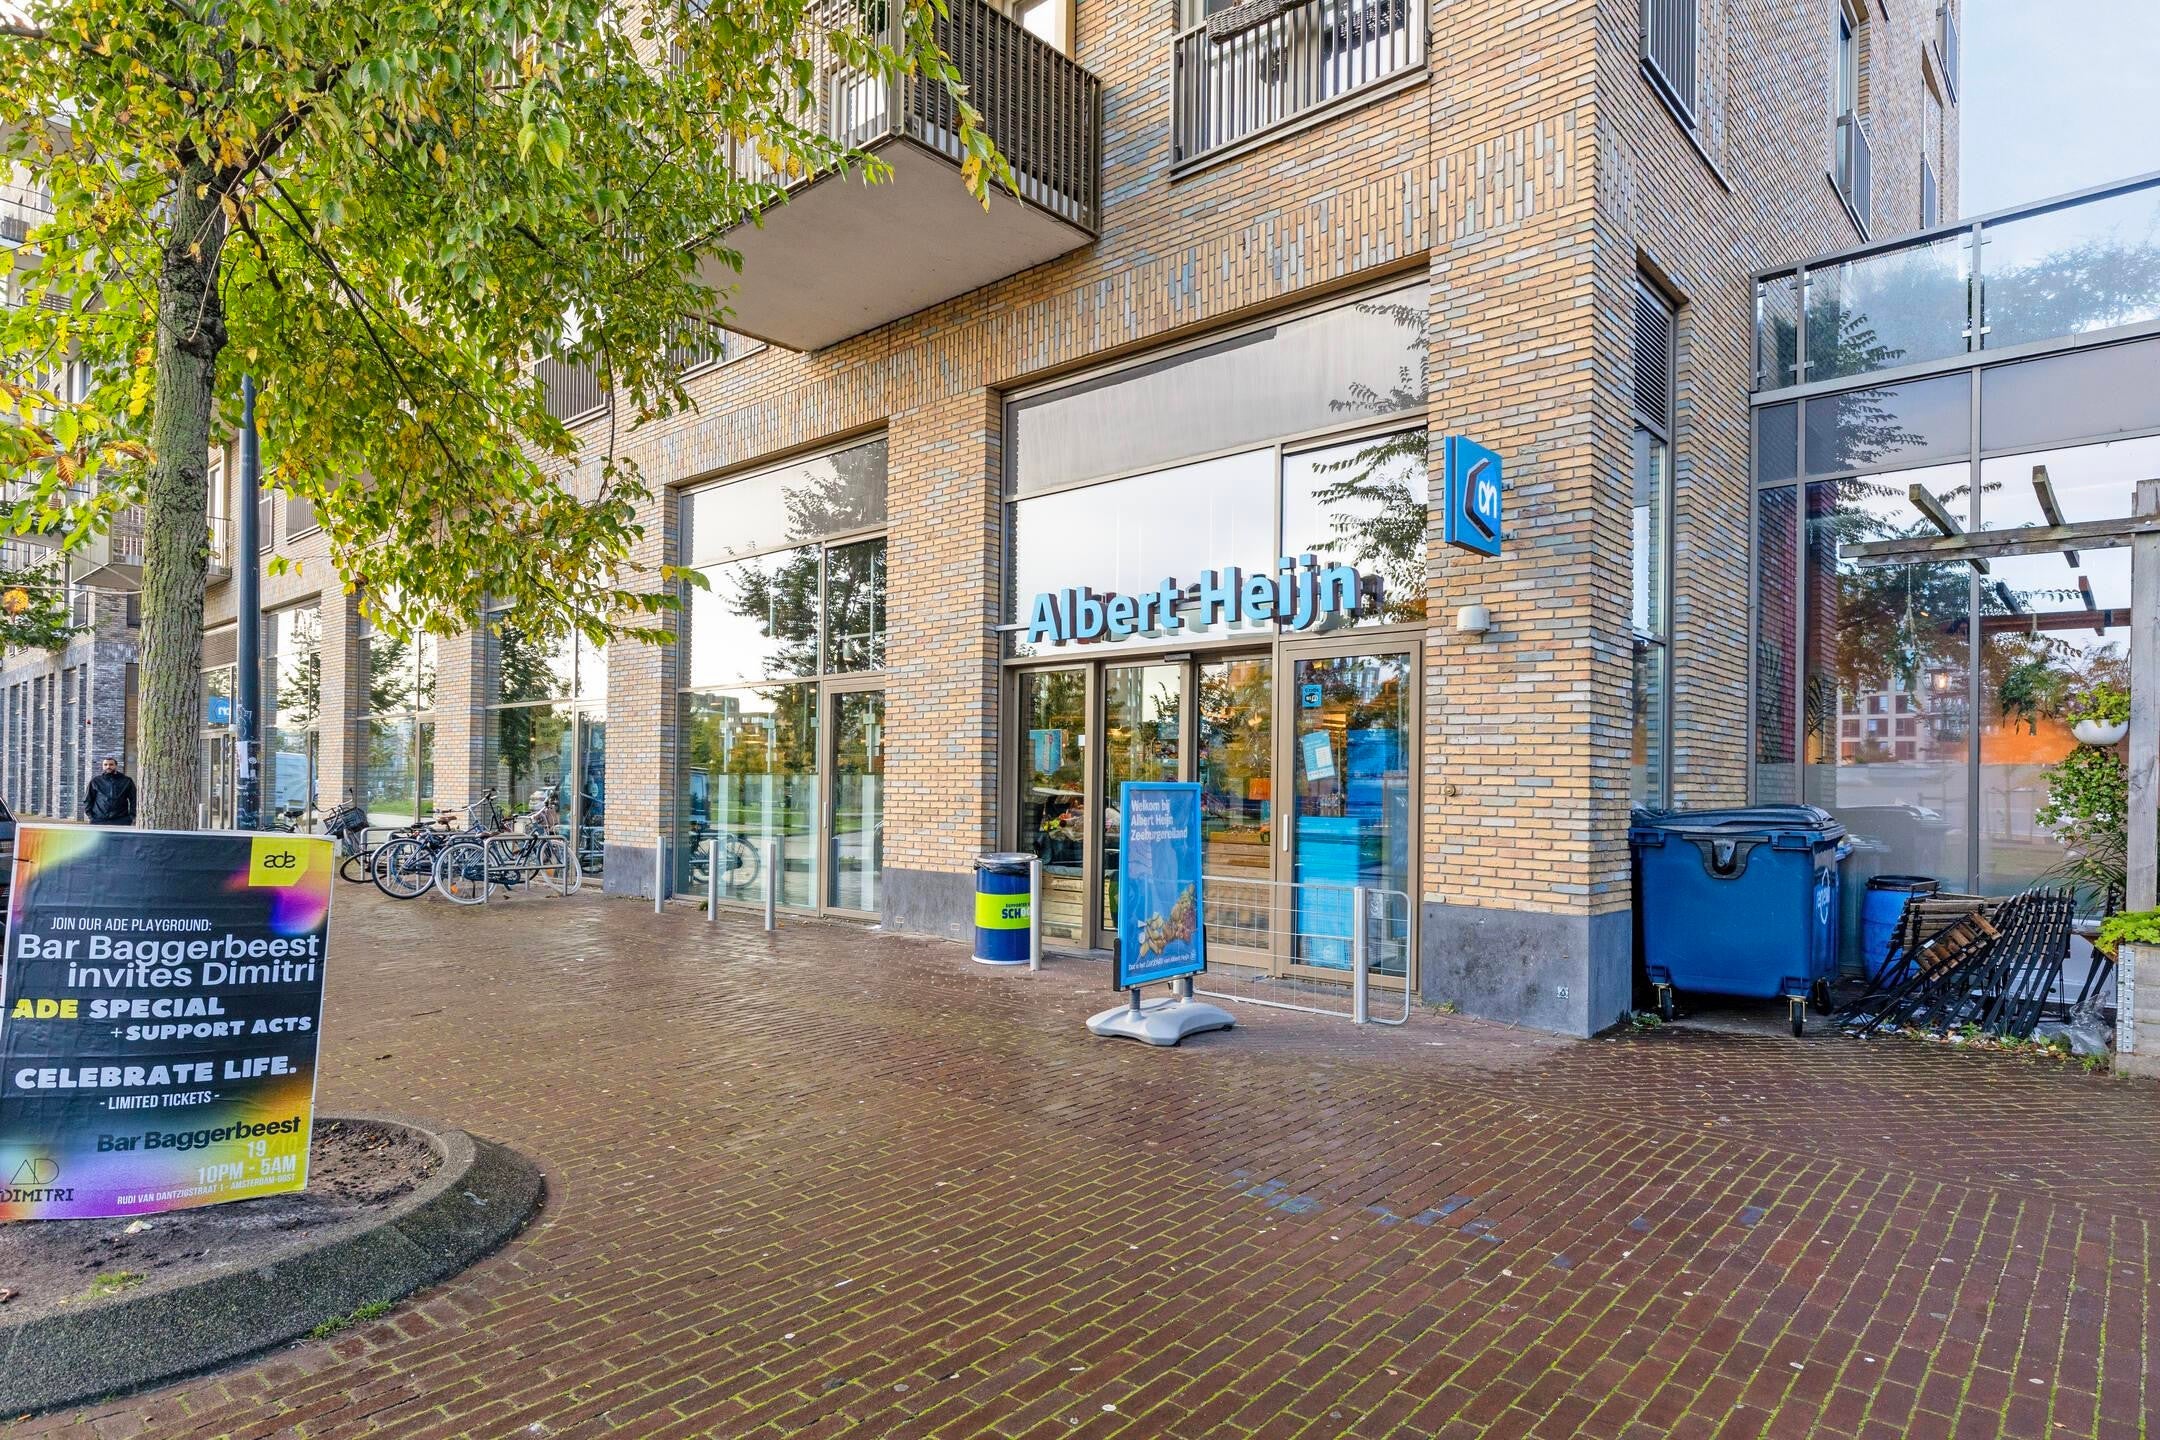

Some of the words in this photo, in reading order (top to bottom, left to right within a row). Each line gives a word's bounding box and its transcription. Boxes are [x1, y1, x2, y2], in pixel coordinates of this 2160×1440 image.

[1026, 576, 1183, 643] Albert
[1200, 553, 1362, 631] Heijn
[1131, 800, 1160, 811] Welkom
[1161, 799, 1170, 813] bij
[1131, 814, 1154, 826] Albert
[1155, 813, 1173, 827] Heijn
[1131, 826, 1188, 841] Zeeburgereiland
[51, 917, 75, 930] JOIN
[79, 918, 101, 930] OUR
[105, 918, 128, 931] ADE
[132, 919, 212, 932] PLAYGROUND:
[17, 934, 80, 959] Bar
[89, 934, 320, 967] Baggerbeest
[68, 961, 193, 988] invites
[202, 958, 316, 986] Dimitri
[12, 998, 79, 1019] ADE
[88, 997, 225, 1019] SPECIAL
[251, 1016, 312, 1034] ACTS
[15, 1062, 214, 1089] CELEBRATE
[224, 1056, 297, 1080] LIFE.
[108, 1095, 158, 1110] LIMITED
[161, 1090, 212, 1107] TICKETS
[97, 1133, 142, 1152] Bar
[144, 1116, 301, 1151] Baggerbeest
[199, 1161, 244, 1184] 10PM
[261, 1154, 296, 1175] 5AM
[0, 1188, 74, 1202] DIMITRI
[117, 1194, 136, 1205] RUDI
[138, 1192, 154, 1203] VAN
[156, 1184, 217, 1201] DANTZIGSTRAAT
